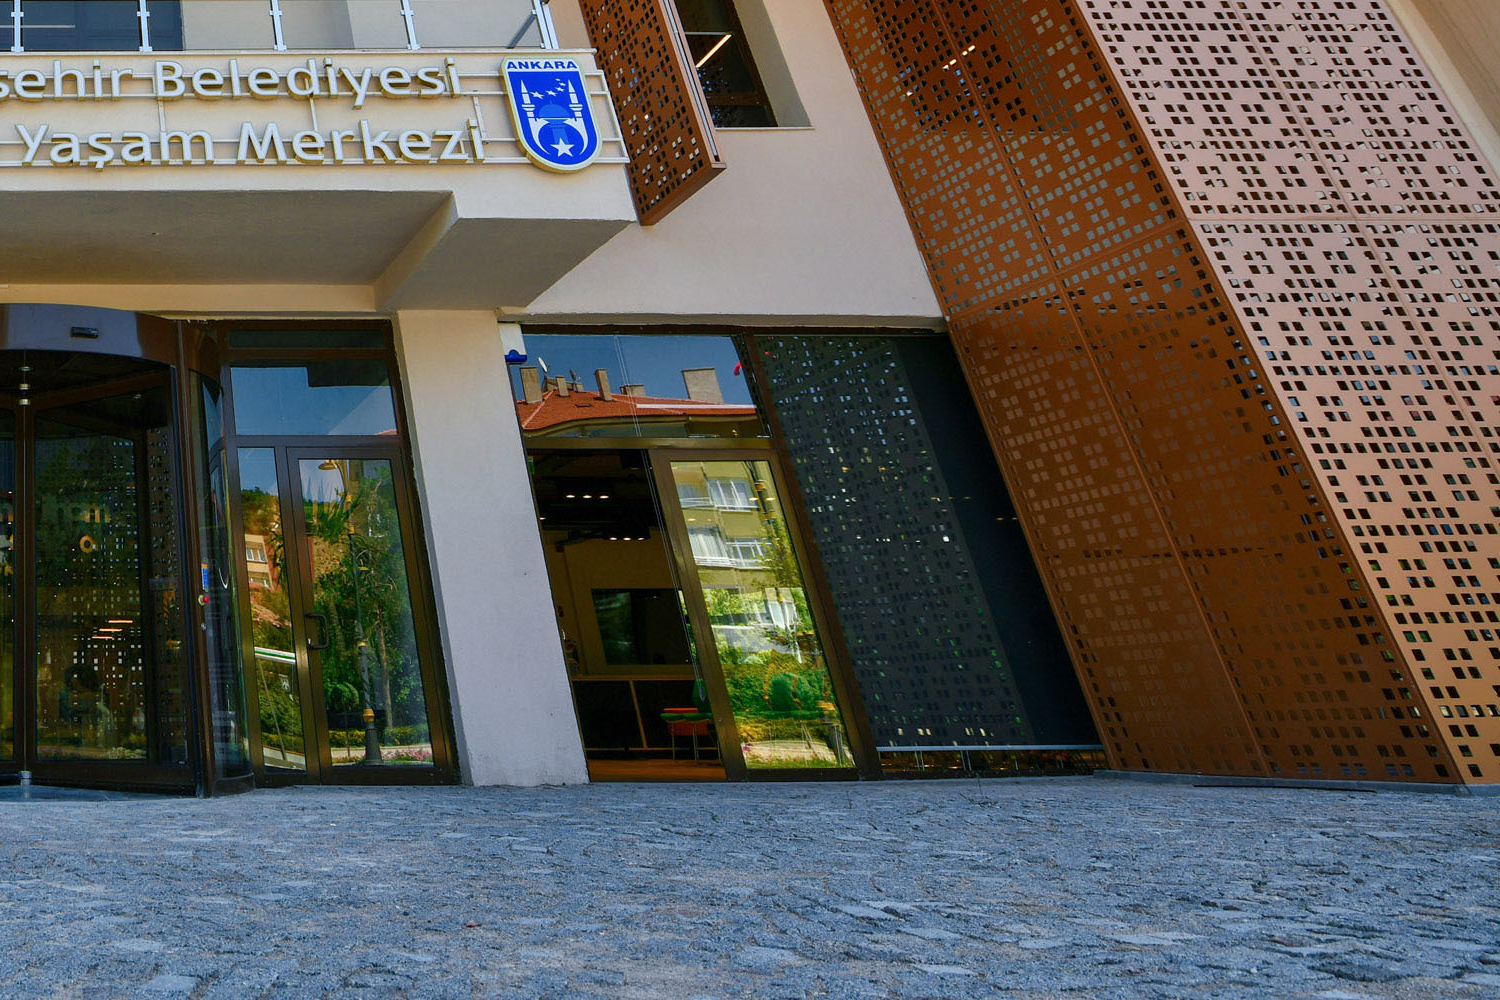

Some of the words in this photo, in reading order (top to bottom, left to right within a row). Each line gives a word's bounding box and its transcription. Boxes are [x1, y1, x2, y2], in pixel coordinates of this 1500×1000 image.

[154, 56, 463, 109] Belediyesi
[506, 59, 580, 71] ANKARA
[15, 122, 216, 171] Yaşam
[236, 117, 485, 164] Merkezi
